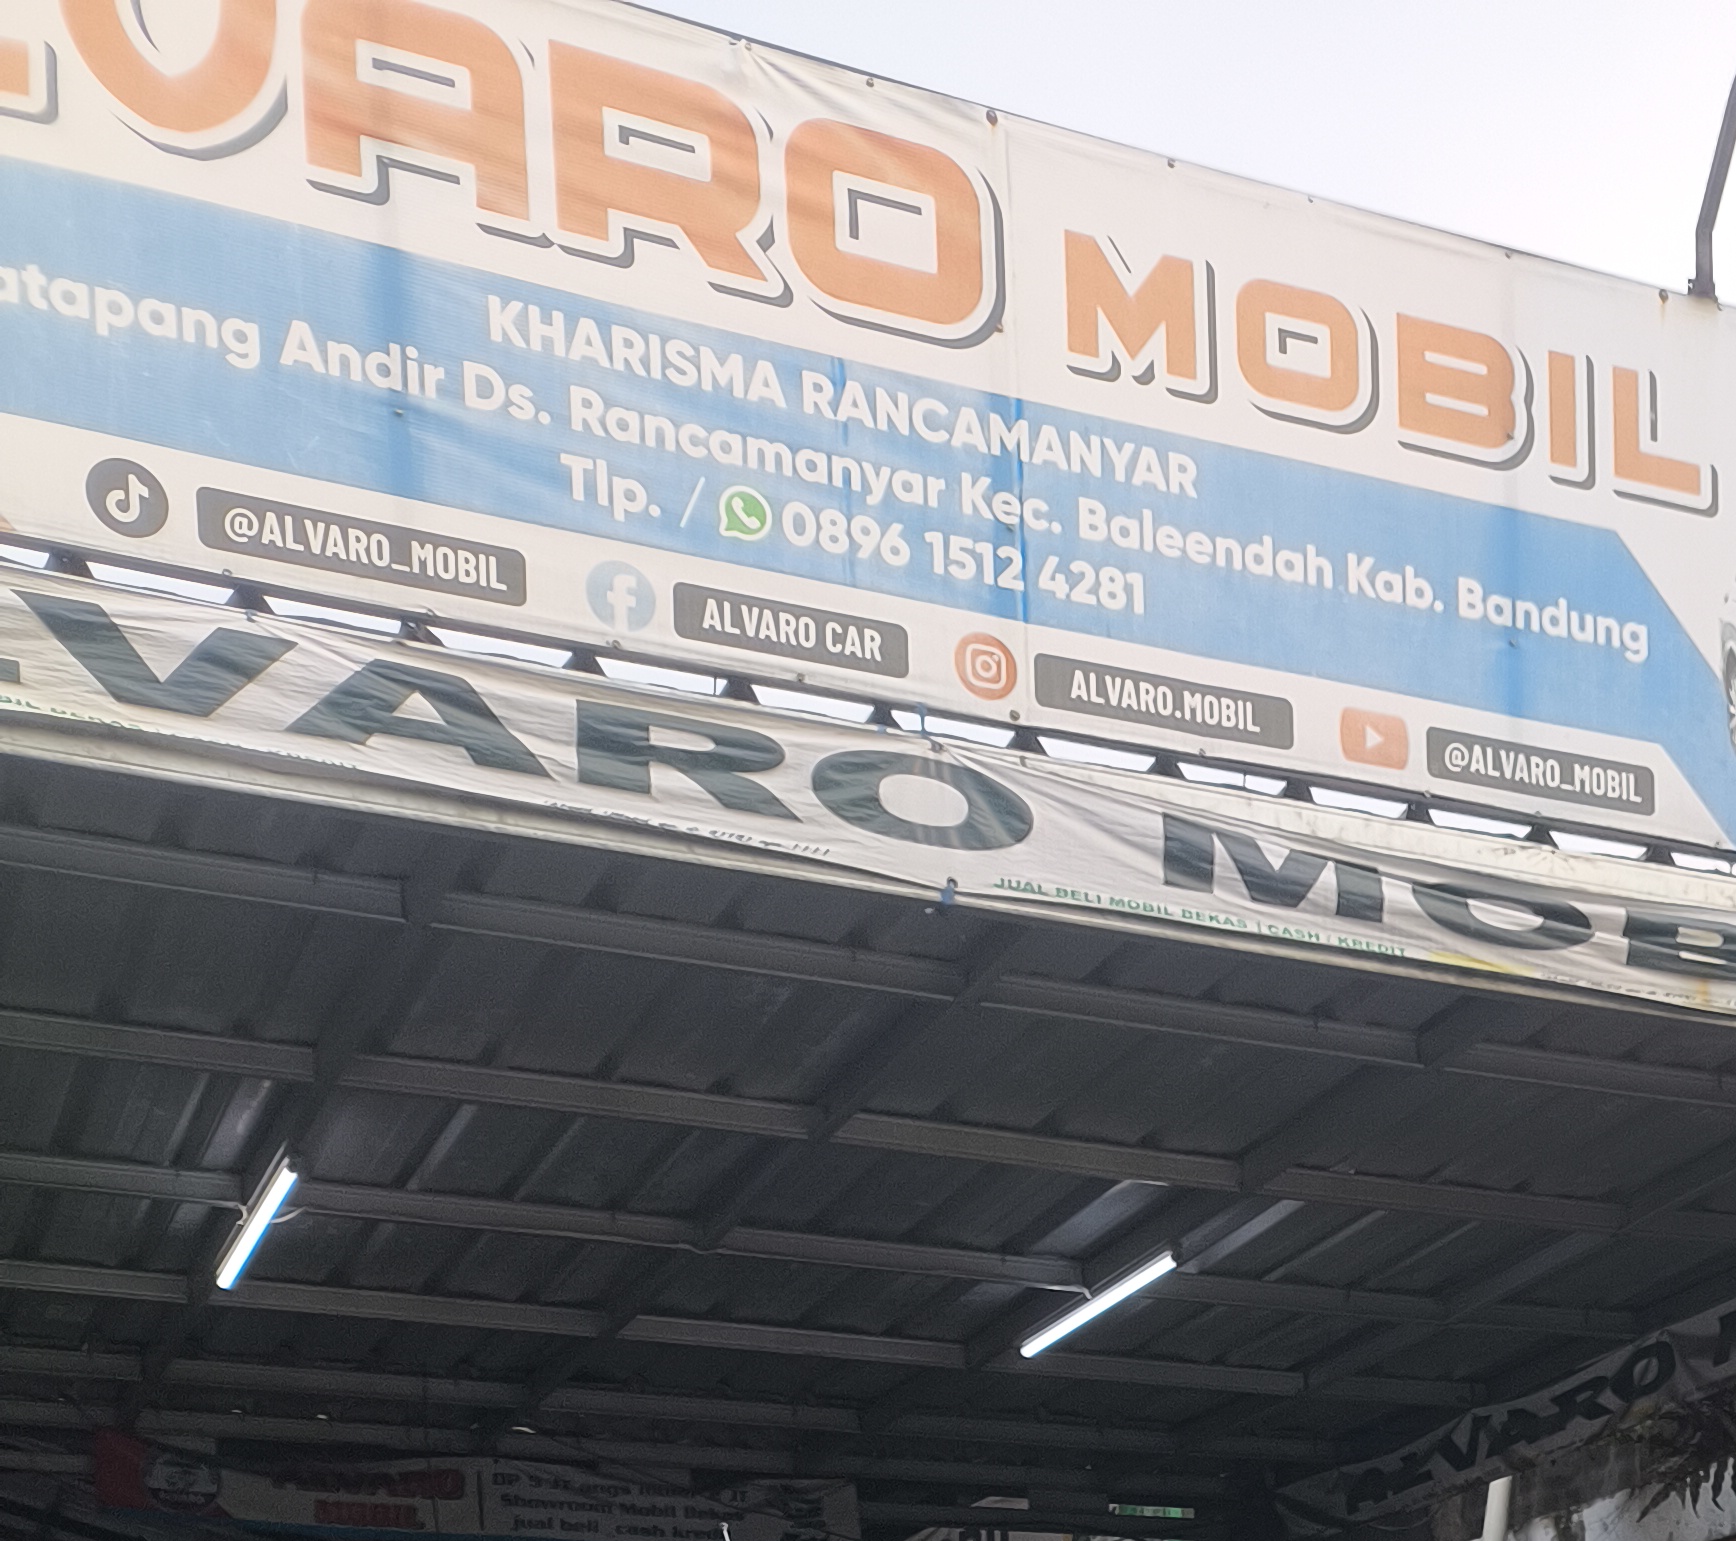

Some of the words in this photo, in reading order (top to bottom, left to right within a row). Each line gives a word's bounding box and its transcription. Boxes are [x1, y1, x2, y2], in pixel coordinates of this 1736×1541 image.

[0, 0, 1005, 349] VARO
[1063, 229, 1718, 516] MOBIL
[486, 295, 787, 410] KHARISMA
[803, 370, 1198, 499] RANCAMANYAR
[223, 505, 508, 592] @ALVARO_MOBIL
[280, 319, 445, 400] Andir
[463, 361, 552, 426] Ds.
[570, 384, 946, 513] Rancamanyar
[961, 468, 1062, 536] Kec.
[1078, 495, 1333, 589] Baleendah
[1347, 553, 1445, 613] Kab.
[1458, 576, 1649, 662] Bandung
[560, 454, 661, 523] Tlp.
[781, 498, 911, 567] 0896
[924, 528, 1028, 593] 1512
[1038, 554, 1146, 616] 4281
[702, 597, 817, 650] ALVARO
[825, 621, 882, 663] CAR
[0, 590, 1033, 850] VARO
[1070, 669, 1261, 735] ALVARO.MOBIL
[1444, 741, 1643, 805] @ALVARO_MOBIL
[992, 877, 1046, 895] JUAL
[1054, 887, 1102, 905] BELI
[1109, 896, 1173, 918] MOBIL
[1181, 908, 1249, 930] BEKAS
[1267, 922, 1322, 943] CASH
[1336, 935, 1407, 958] KREDIT
